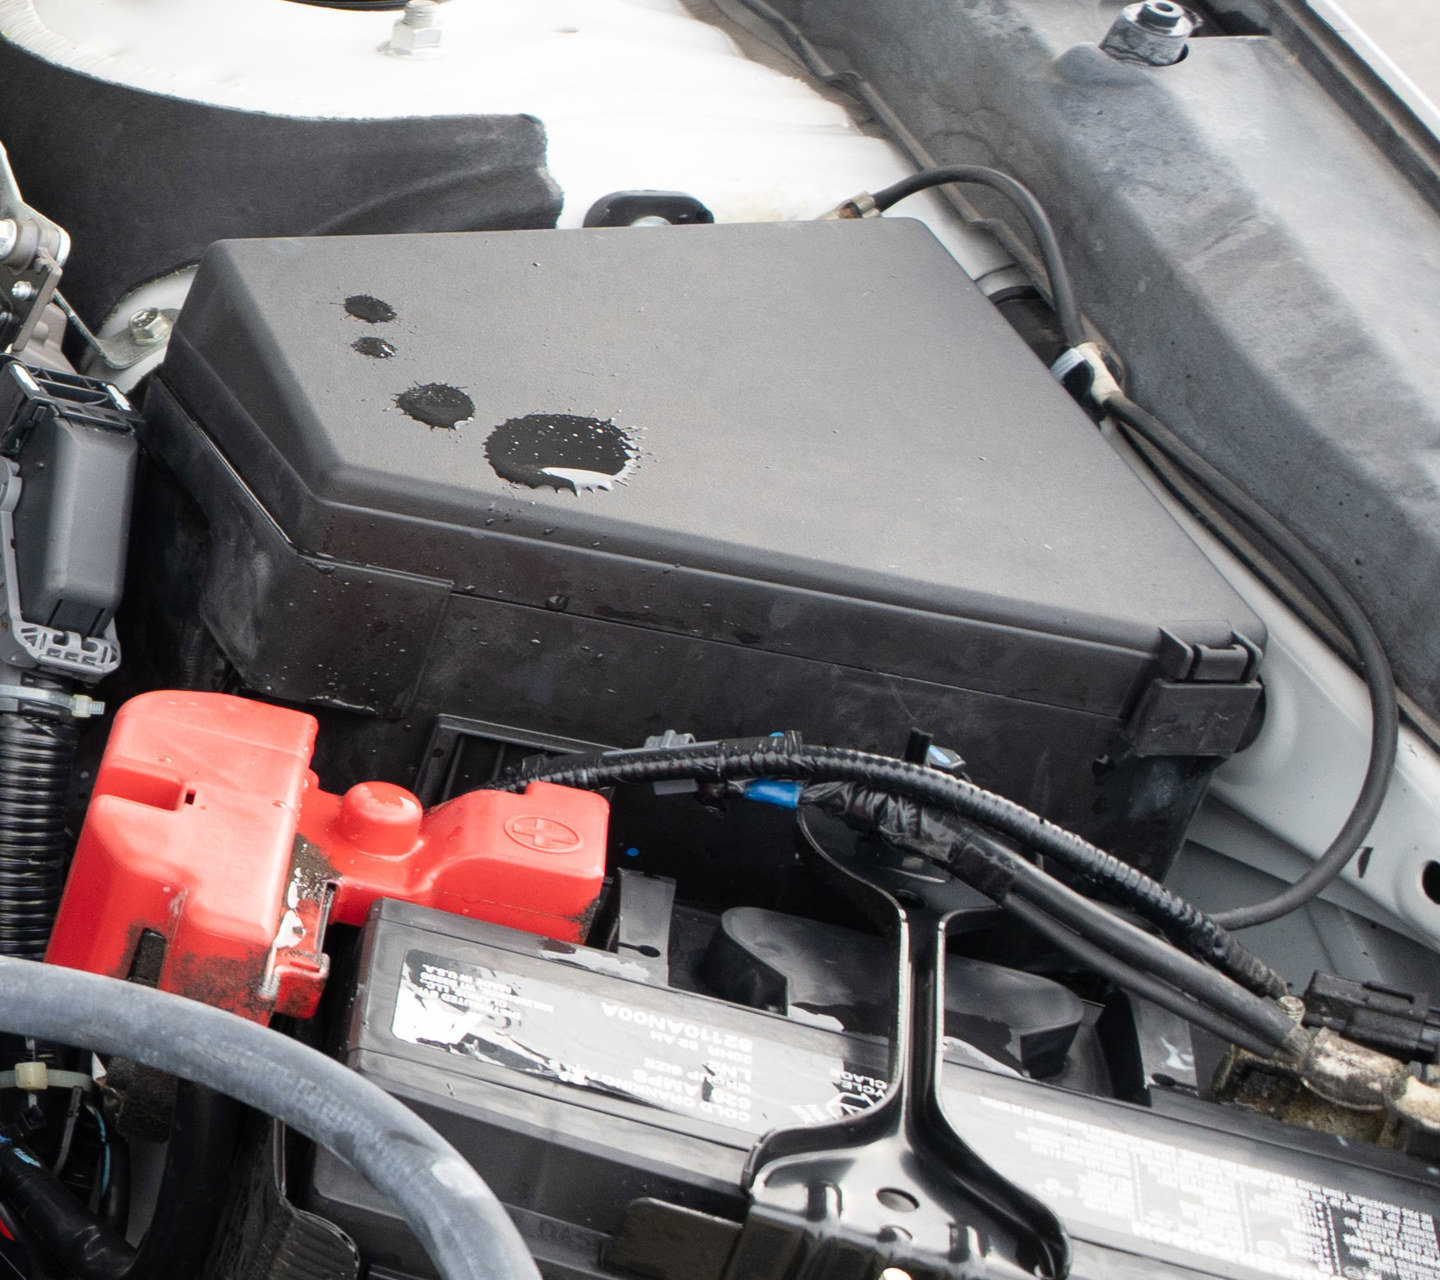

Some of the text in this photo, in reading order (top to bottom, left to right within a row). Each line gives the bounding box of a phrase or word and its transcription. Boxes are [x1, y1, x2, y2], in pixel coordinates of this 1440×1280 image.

[597, 1002, 753, 1052] 82110AN00A
[631, 1068, 700, 1096] AMPS
[641, 1056, 683, 1076] SIZE
[599, 1073, 751, 1122] COLD CRANKING
